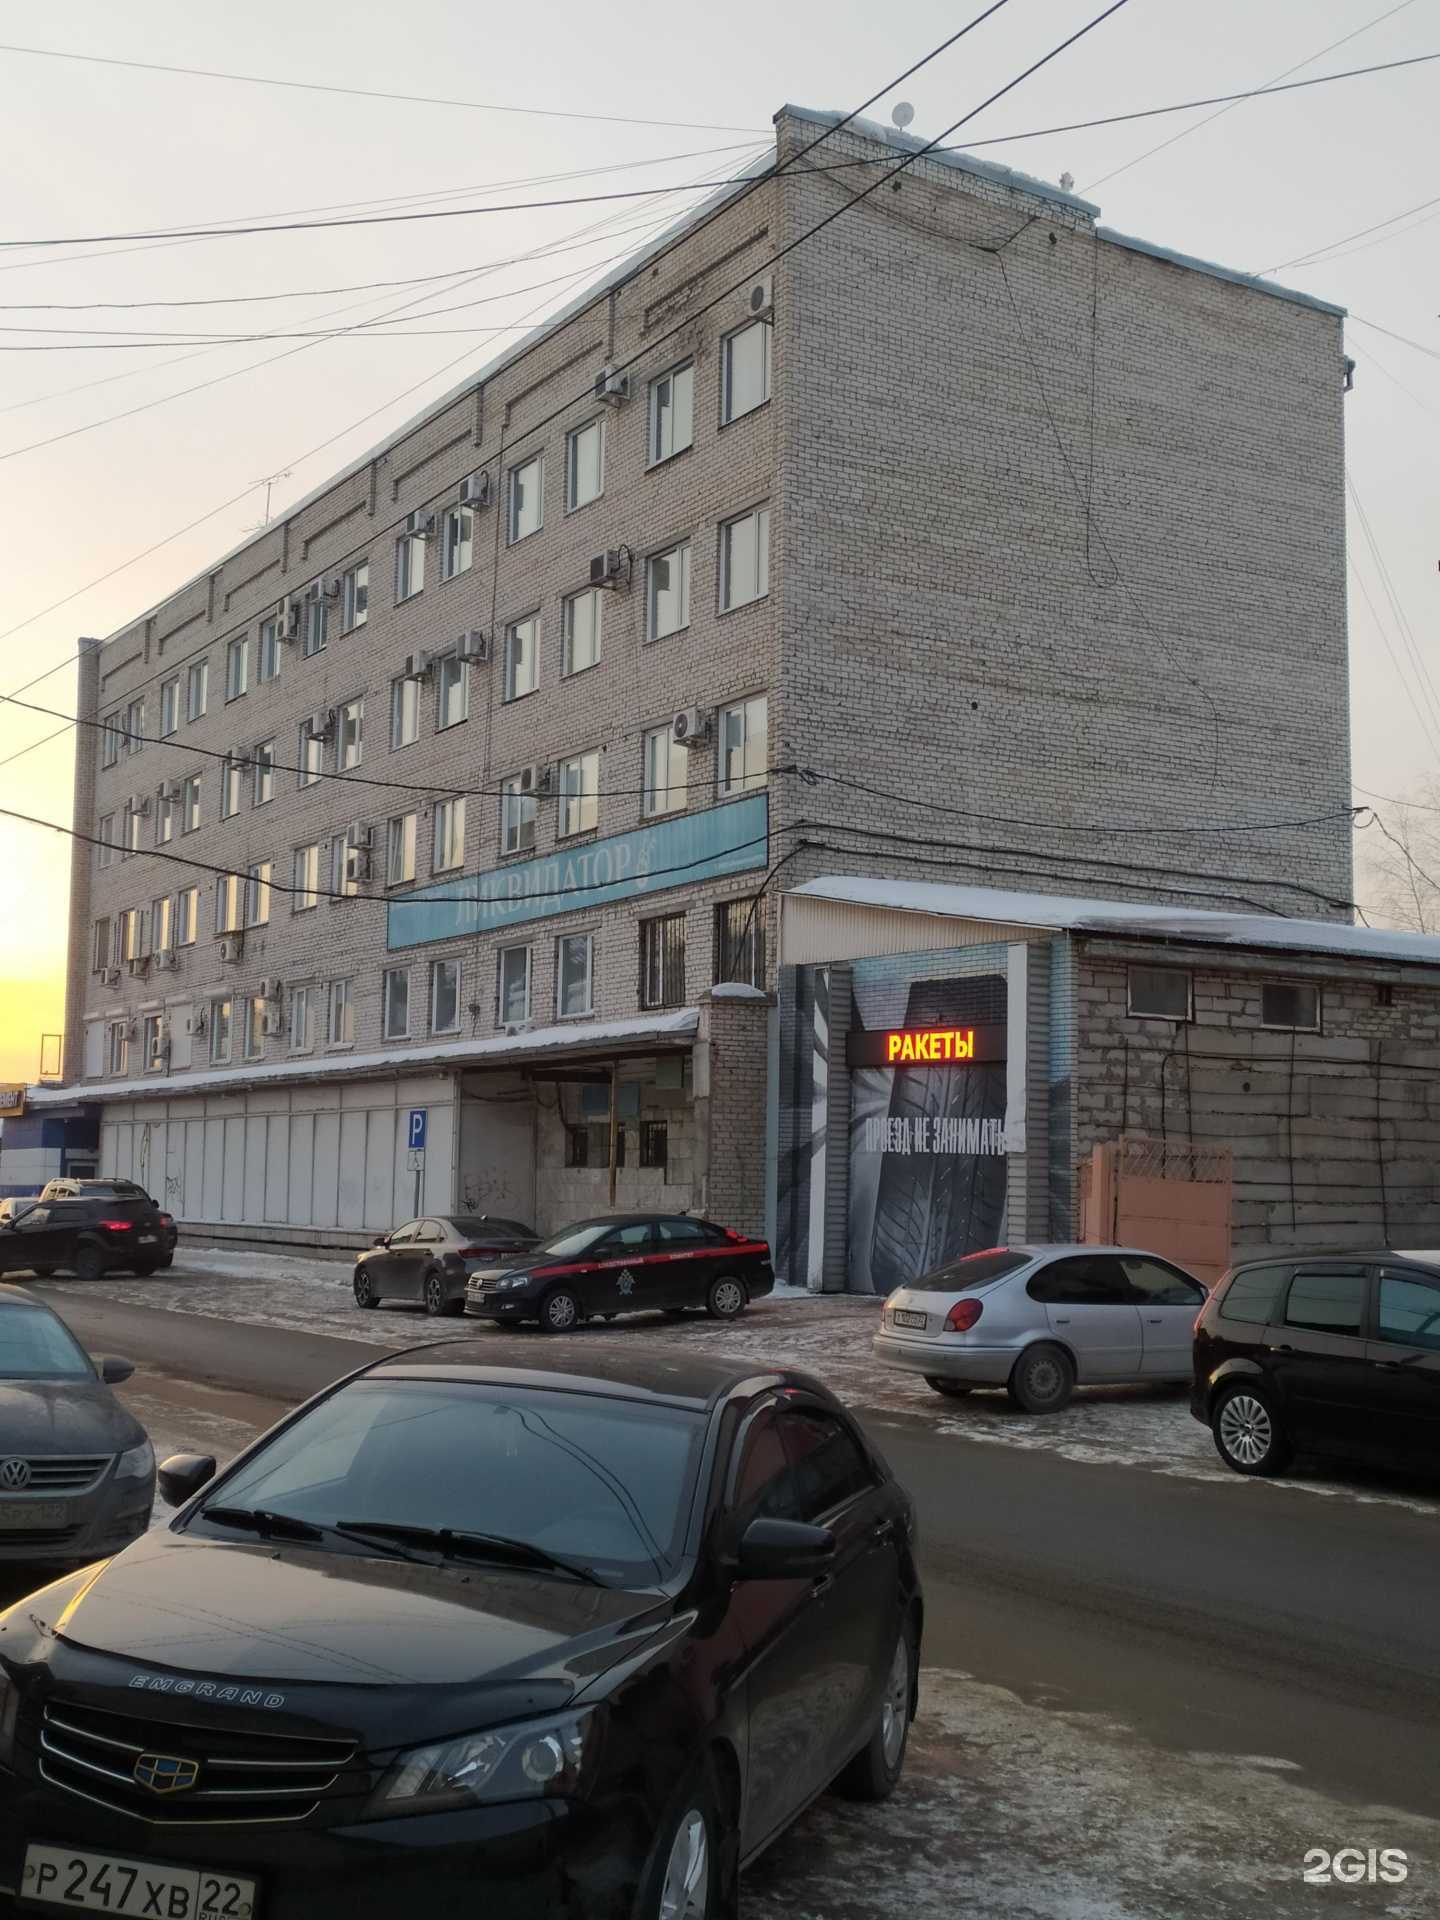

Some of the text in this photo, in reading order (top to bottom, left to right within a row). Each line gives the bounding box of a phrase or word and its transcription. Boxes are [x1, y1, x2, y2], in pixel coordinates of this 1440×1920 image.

[455, 843, 632, 926] ЛИКВИДАТОР
[888, 1030, 974, 1060] РАКЕТЫ
[865, 1117, 1008, 1156] ПРОЕЗД НЕ ЗАНИМАТЬ
[129, 1674, 285, 1708] EMGRAND
[202, 1879, 241, 1916] 22
